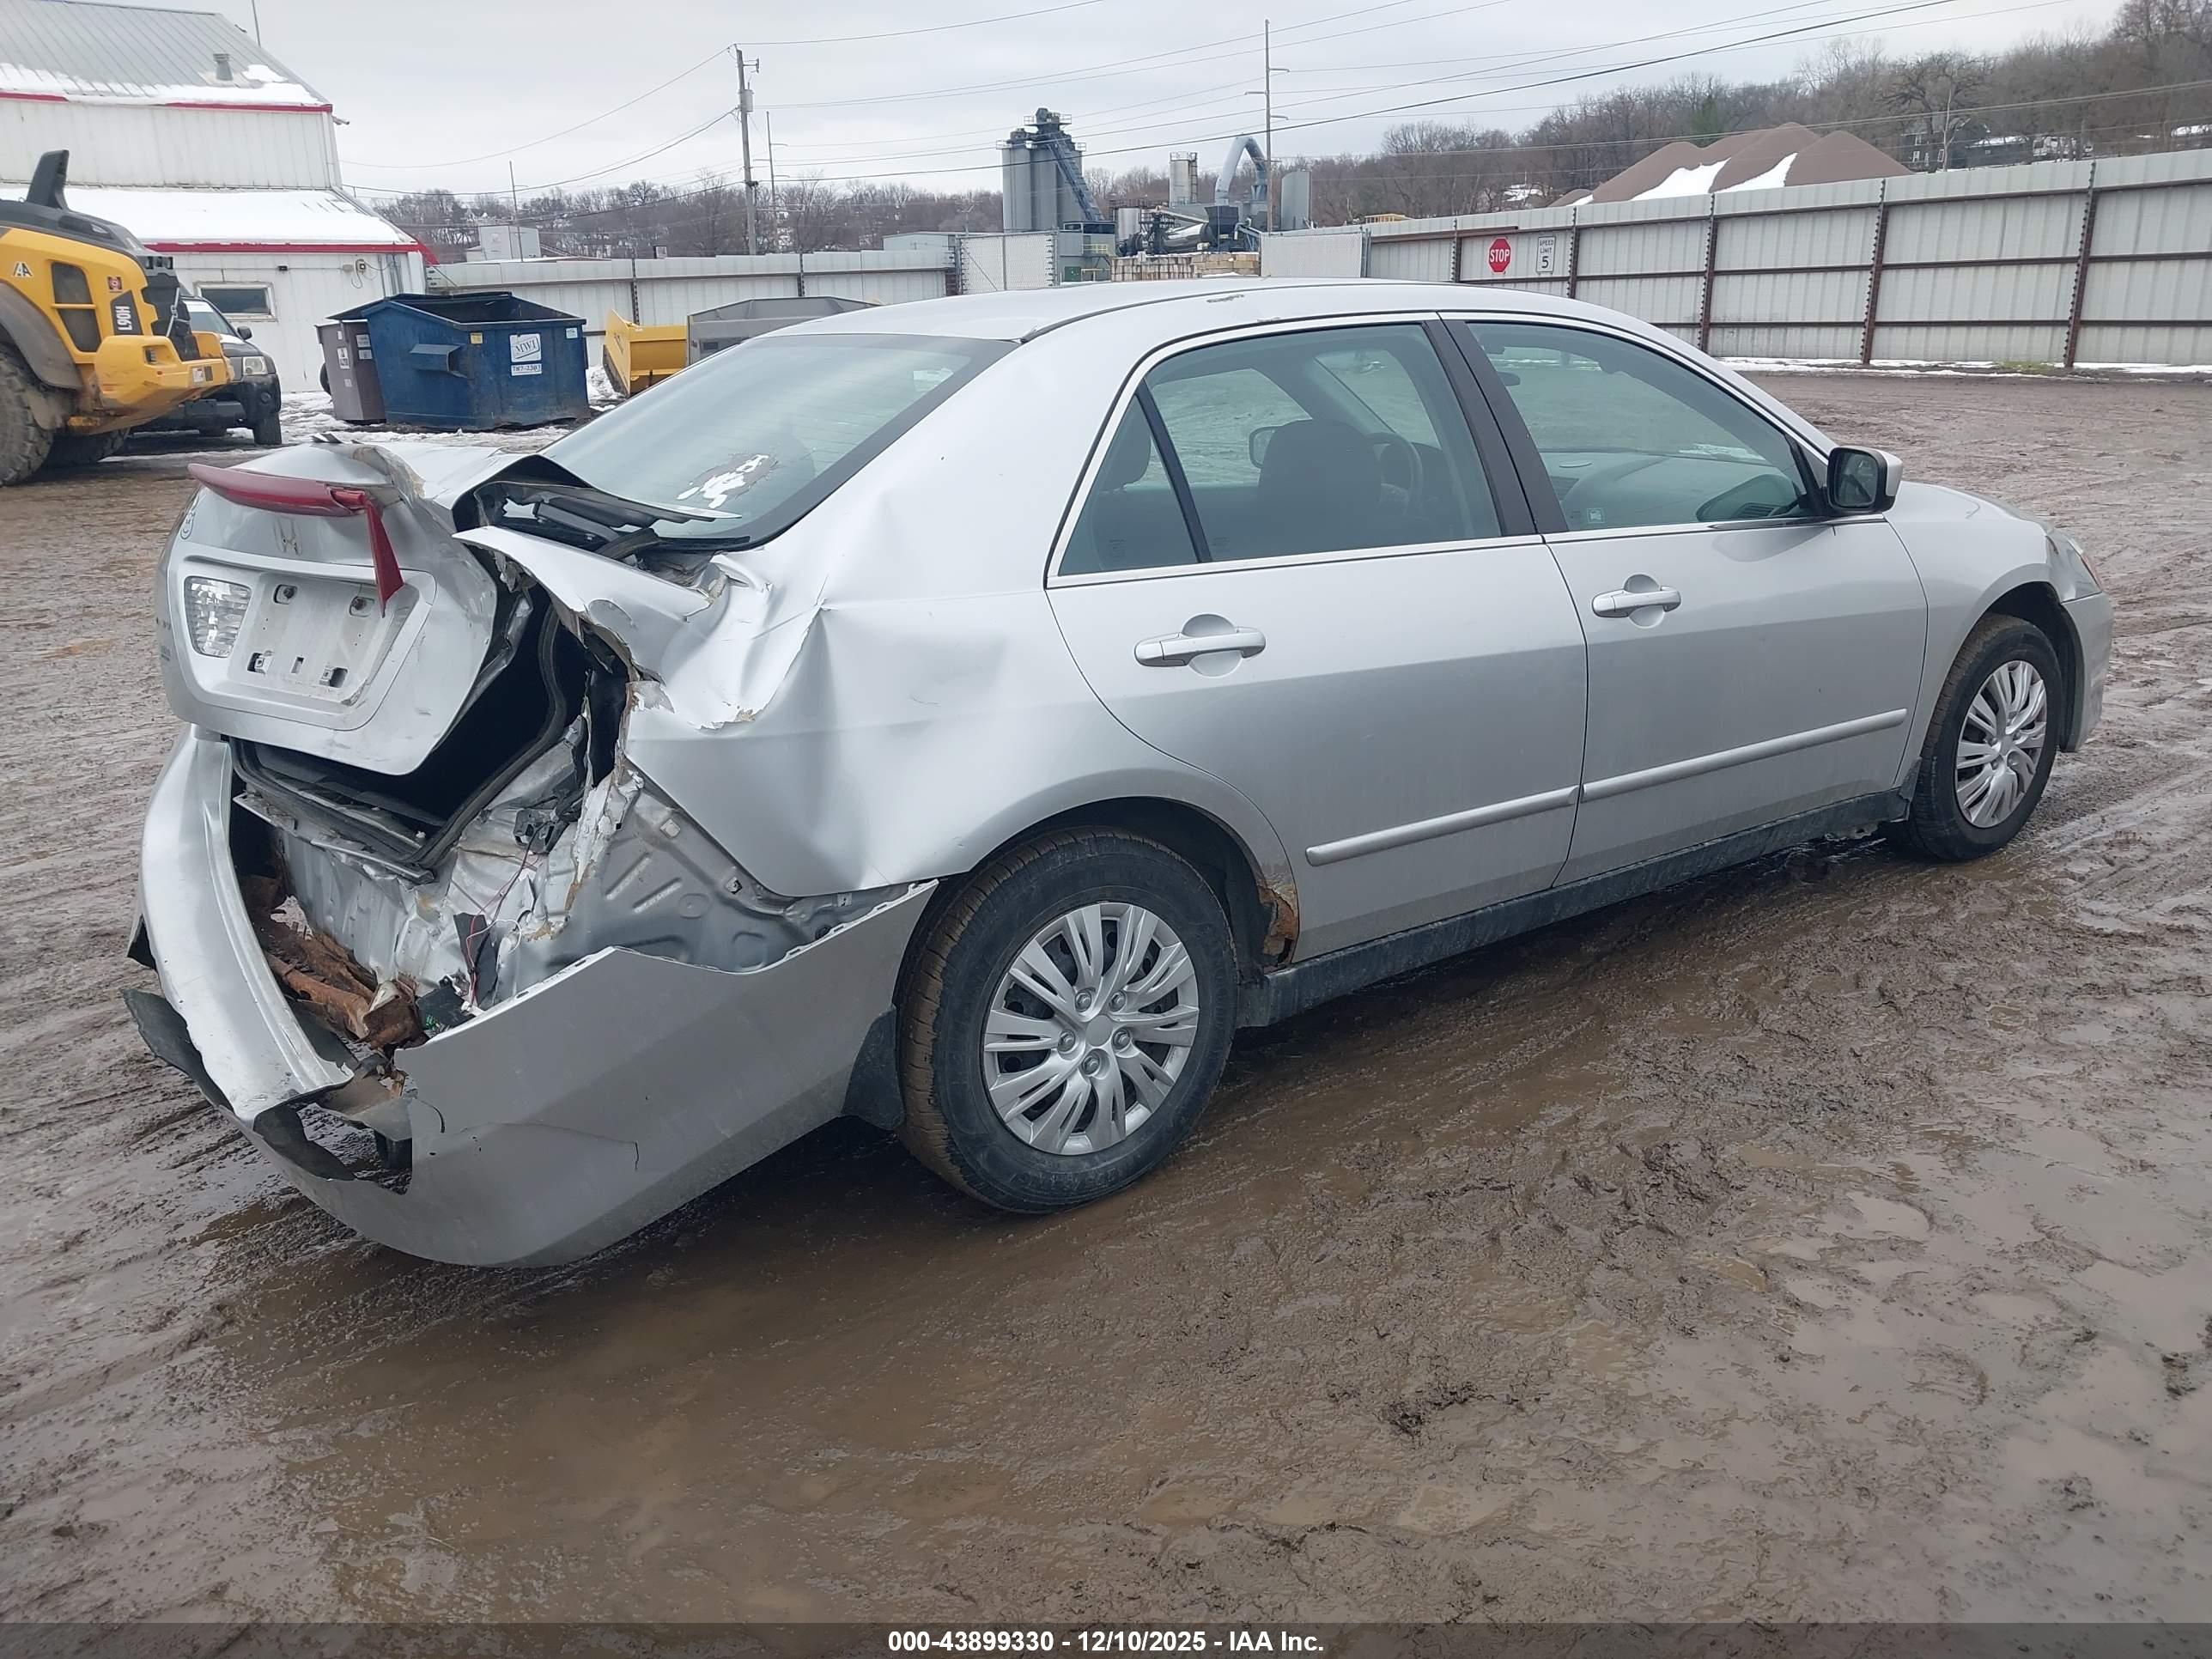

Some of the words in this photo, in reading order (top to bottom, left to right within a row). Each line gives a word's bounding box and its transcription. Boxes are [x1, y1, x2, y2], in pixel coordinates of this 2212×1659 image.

[1490, 248, 1510, 263] STOP
[1541, 256, 1549, 269] 5
[115, 306, 133, 331] L90H
